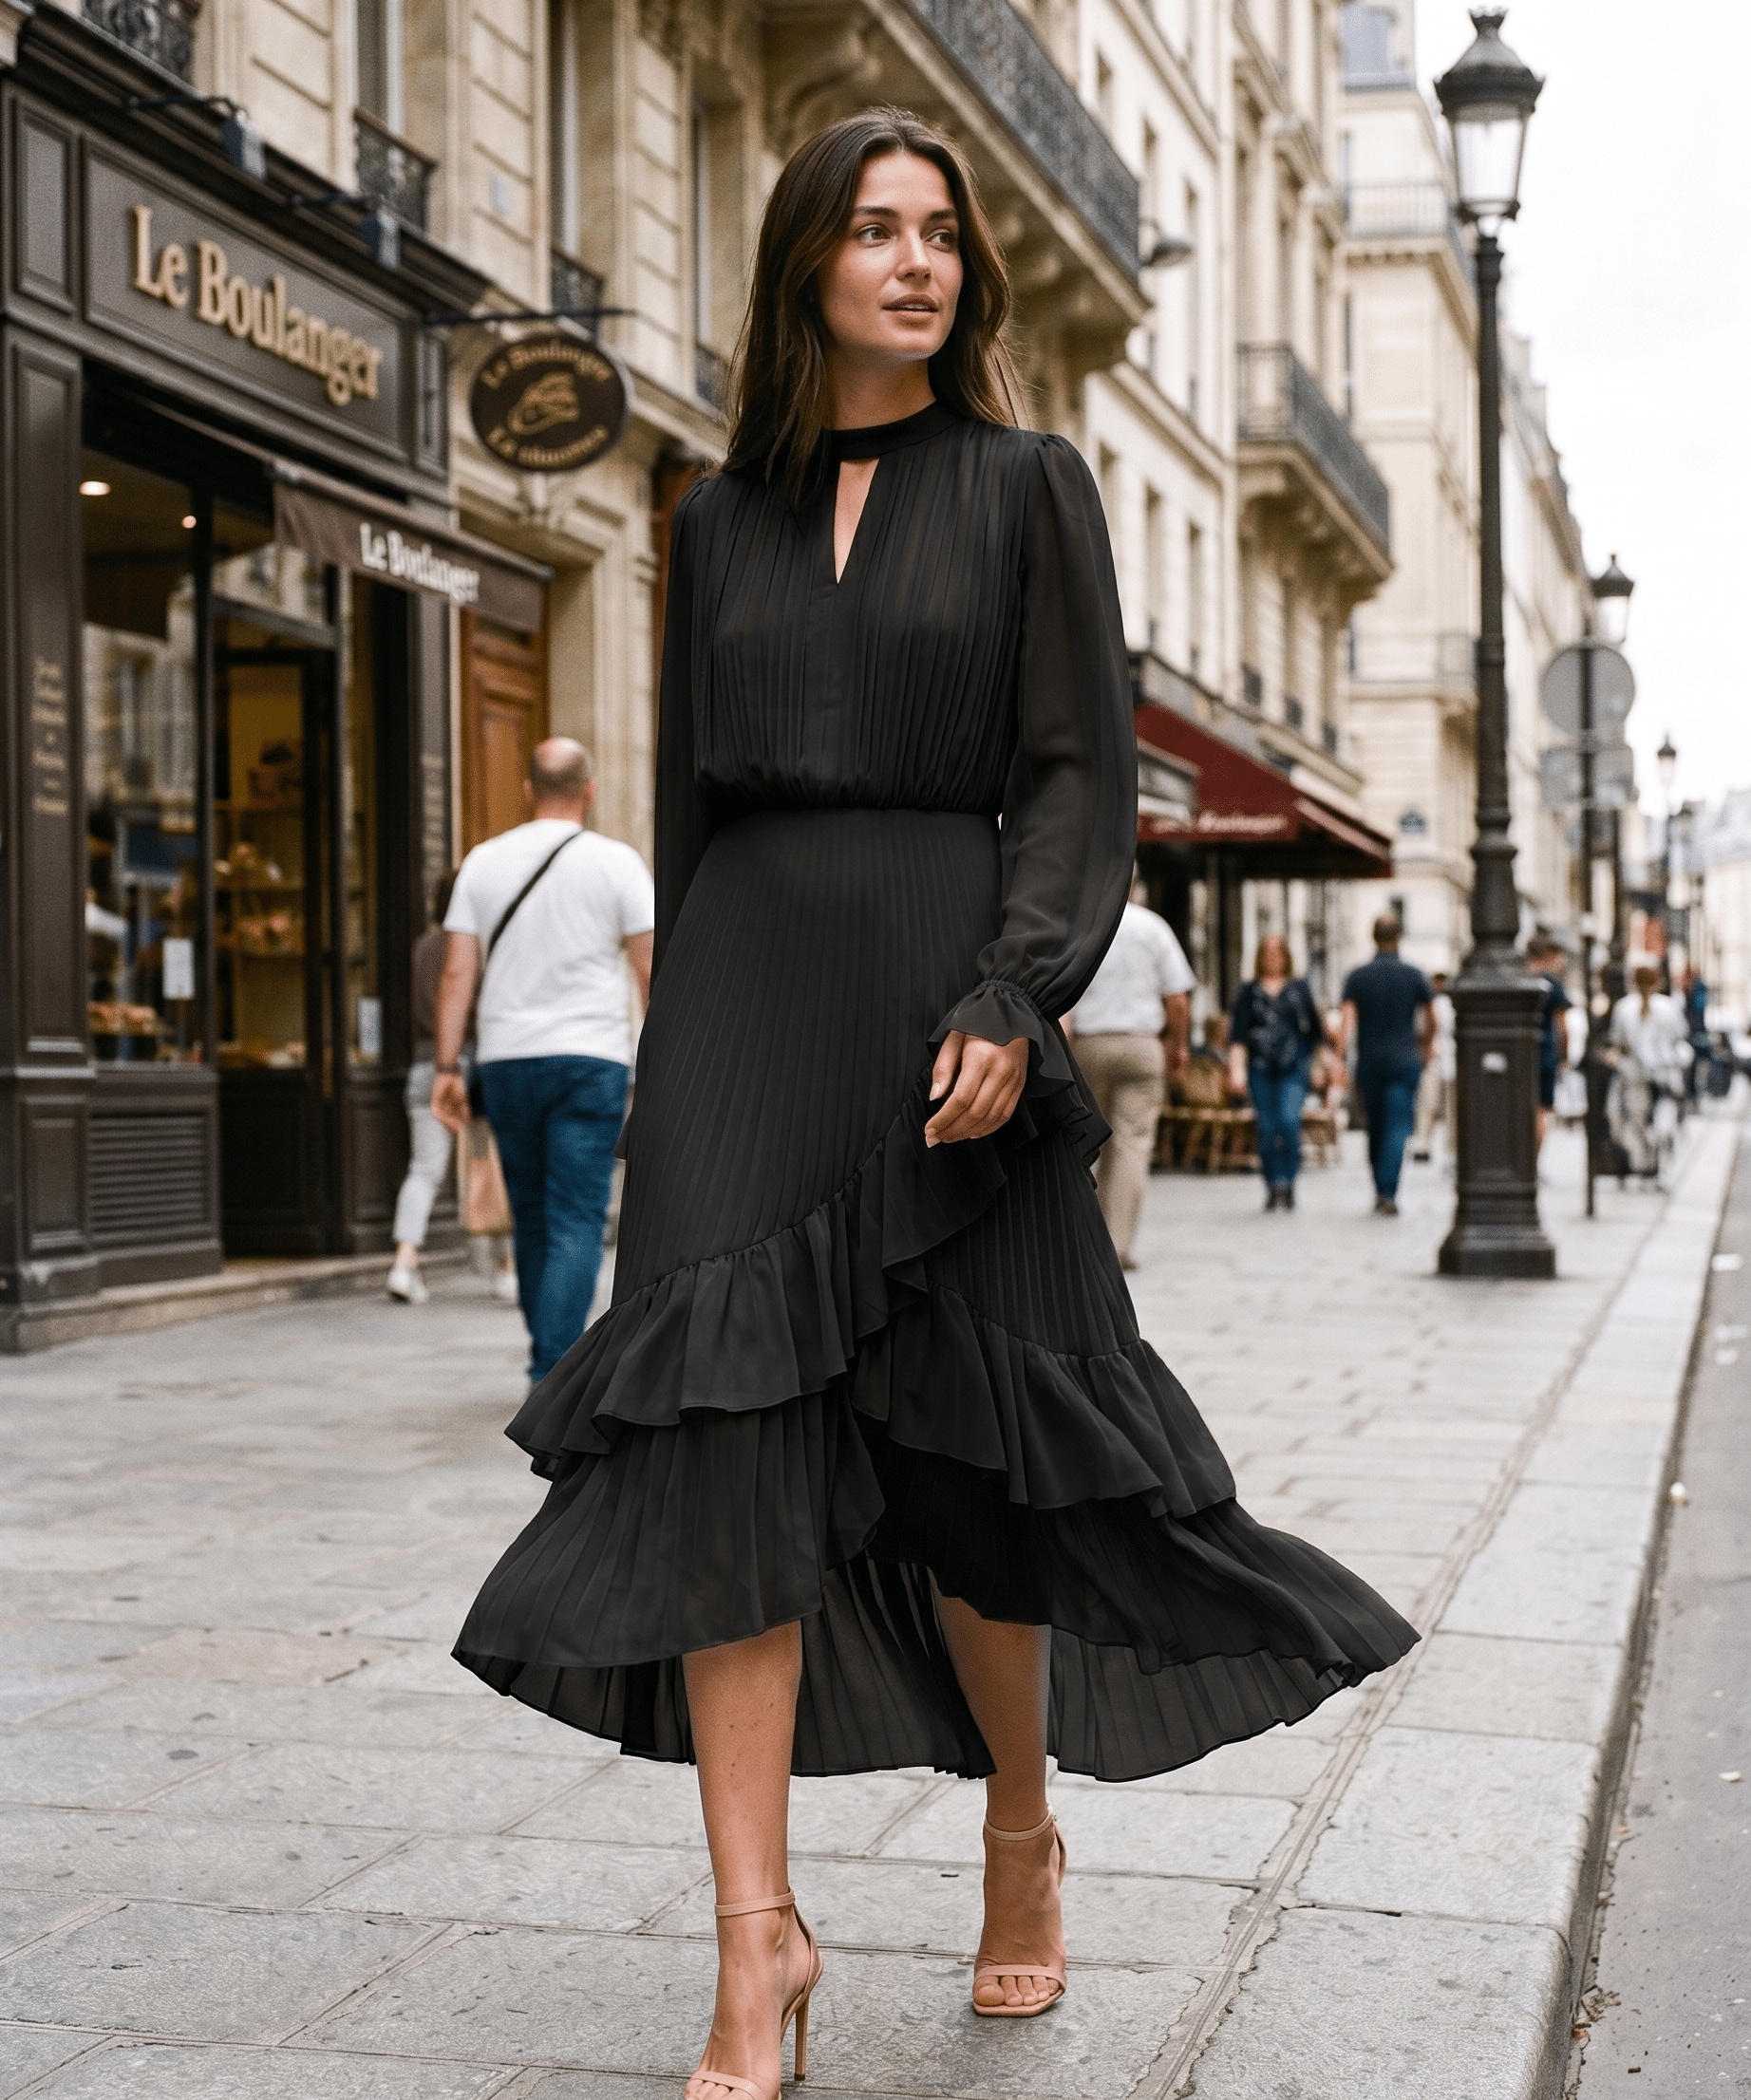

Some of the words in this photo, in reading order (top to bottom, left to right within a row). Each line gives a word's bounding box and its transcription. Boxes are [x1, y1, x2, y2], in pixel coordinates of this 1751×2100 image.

[134, 205, 188, 309] Le
[197, 239, 383, 406] Boulanger
[360, 522, 387, 572] Le
